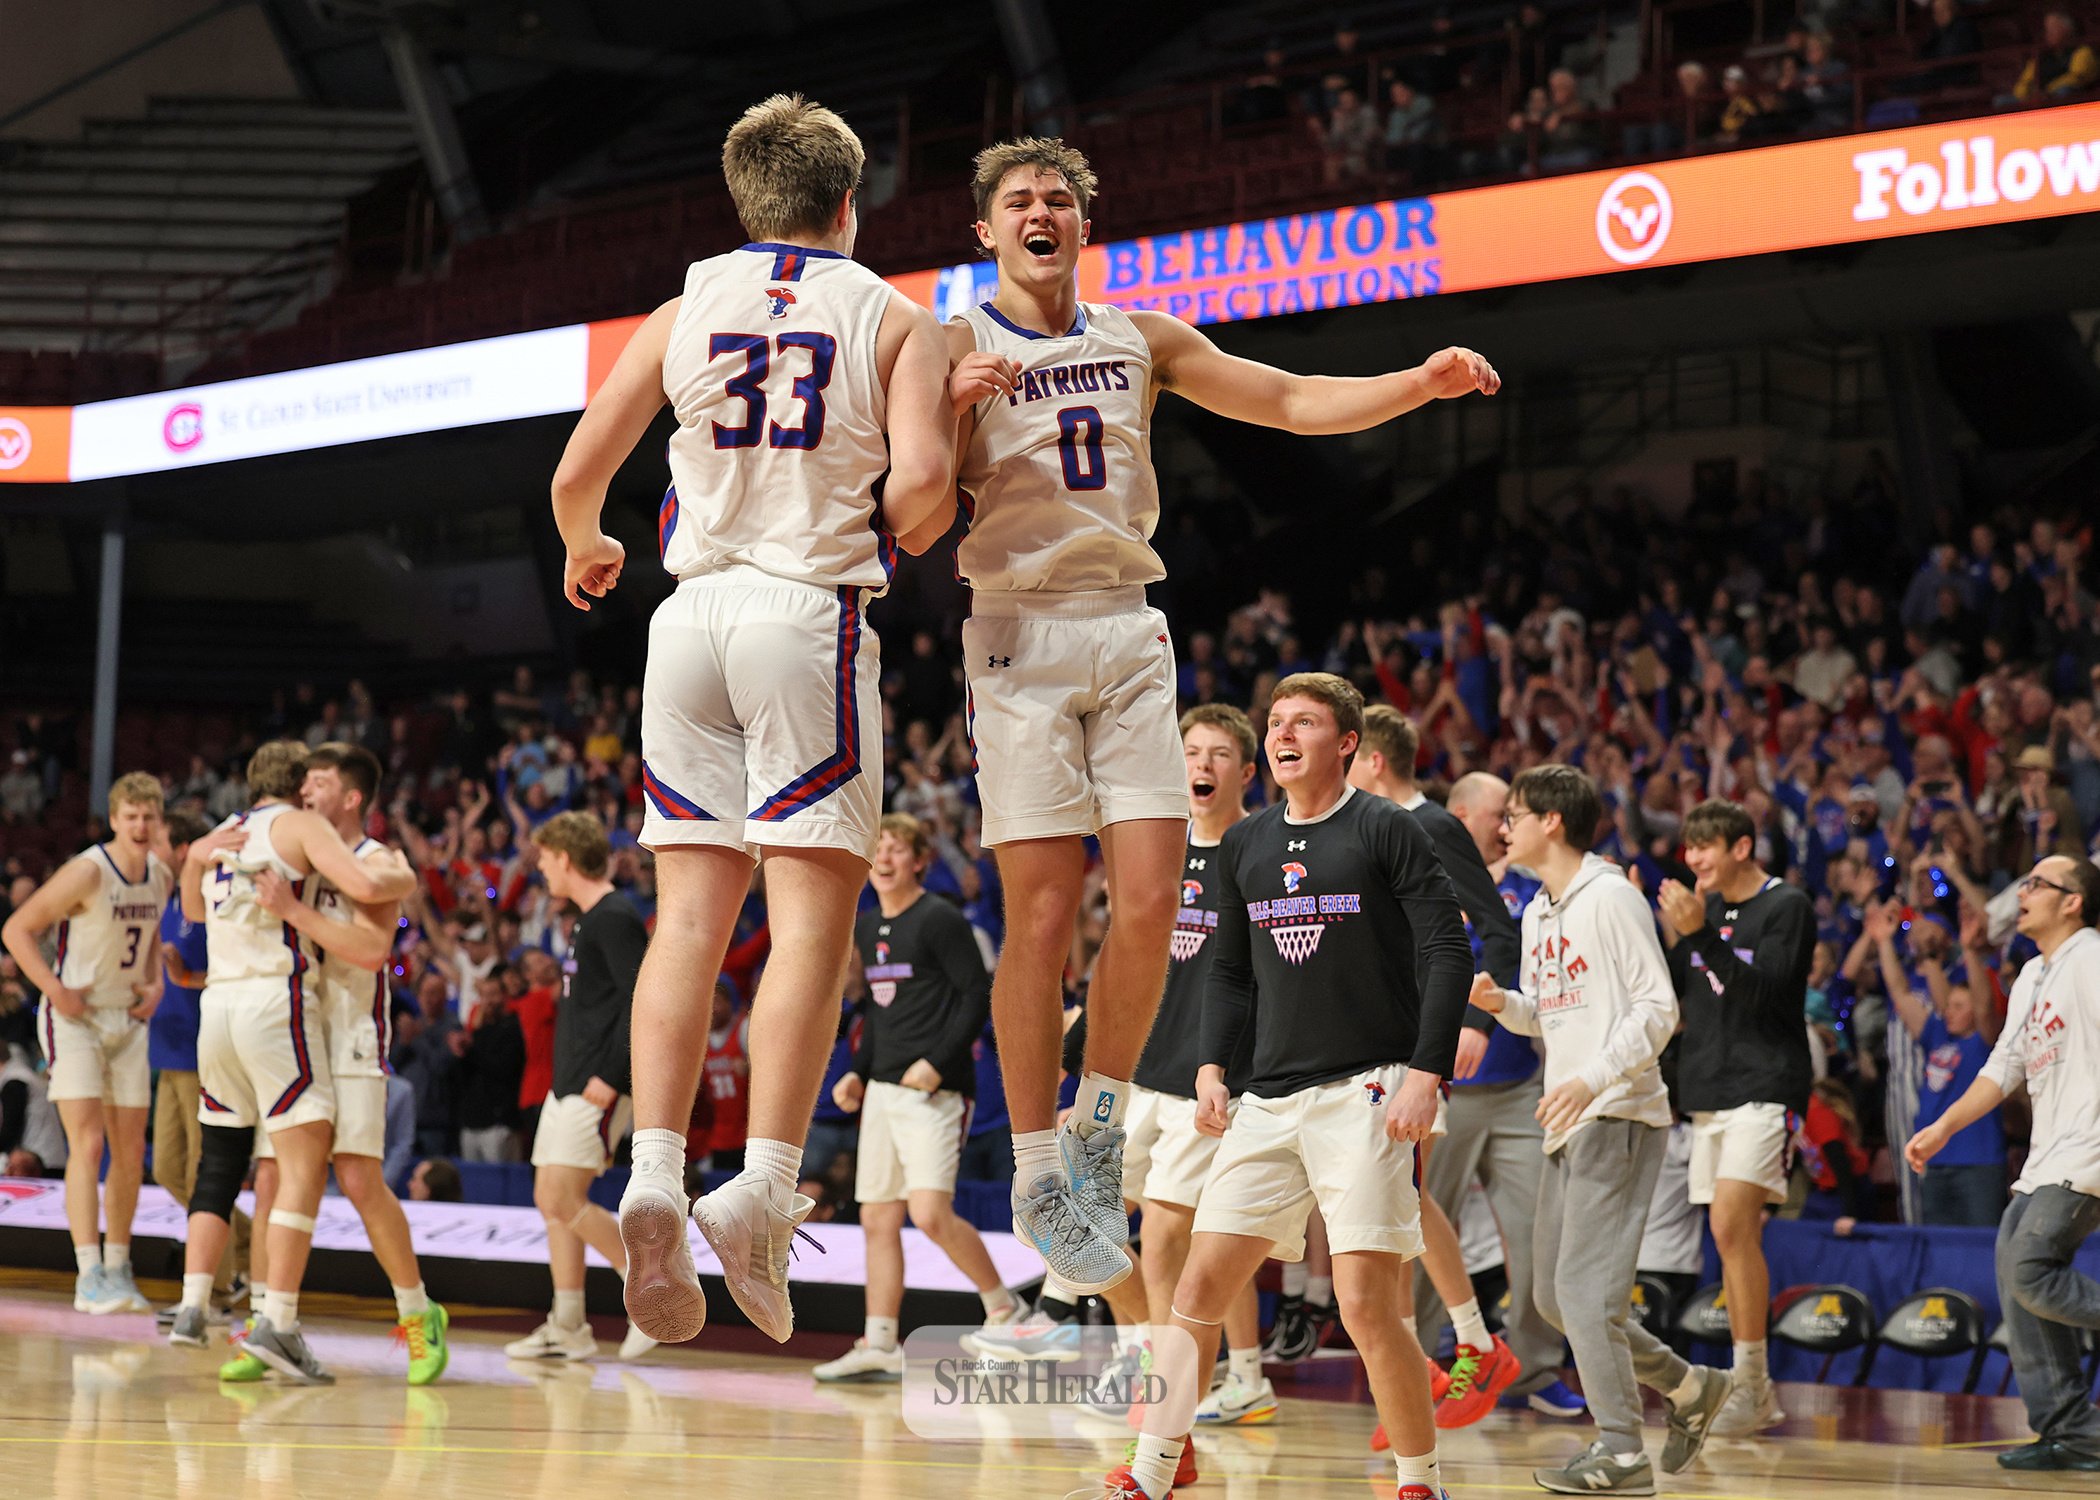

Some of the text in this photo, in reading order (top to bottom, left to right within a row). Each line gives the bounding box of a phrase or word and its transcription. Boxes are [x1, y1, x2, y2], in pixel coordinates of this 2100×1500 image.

[1853, 135, 2100, 222] Follow
[1105, 196, 1437, 291] BEHAVIOR
[1113, 258, 1441, 325] PECTATIONS
[708, 331, 837, 452] 33
[1057, 405, 1107, 491] 0
[1258, 914, 1344, 929] BASKETBALL
[1319, 893, 1361, 914] CREEK
[120, 925, 142, 969] 3
